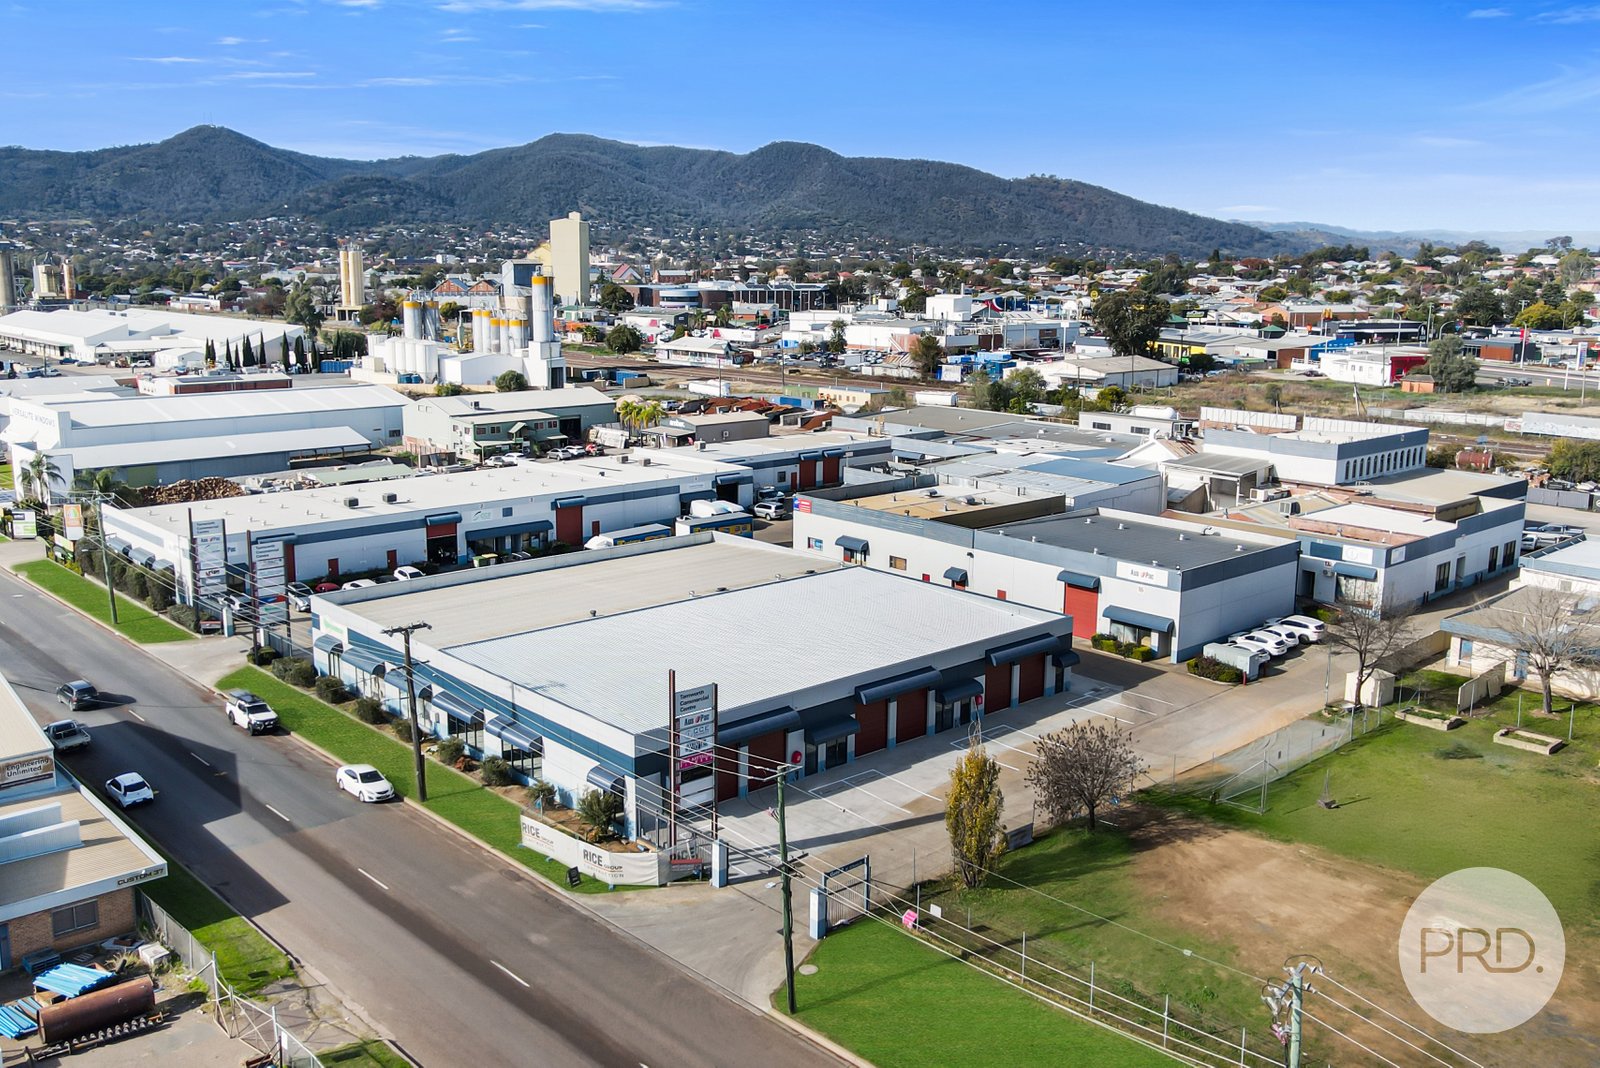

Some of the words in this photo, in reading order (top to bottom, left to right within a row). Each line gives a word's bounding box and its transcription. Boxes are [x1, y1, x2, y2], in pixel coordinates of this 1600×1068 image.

[680, 690, 705, 699] Tamworth
[680, 695, 709, 706] Commercial
[684, 718, 694, 726] Aus
[6, 758, 49, 770] Engineering
[7, 765, 42, 777] Unlimited
[522, 823, 540, 838] RICE
[583, 848, 603, 867] RICE
[118, 872, 152, 885] CUSTOM
[153, 868, 163, 876] 37
